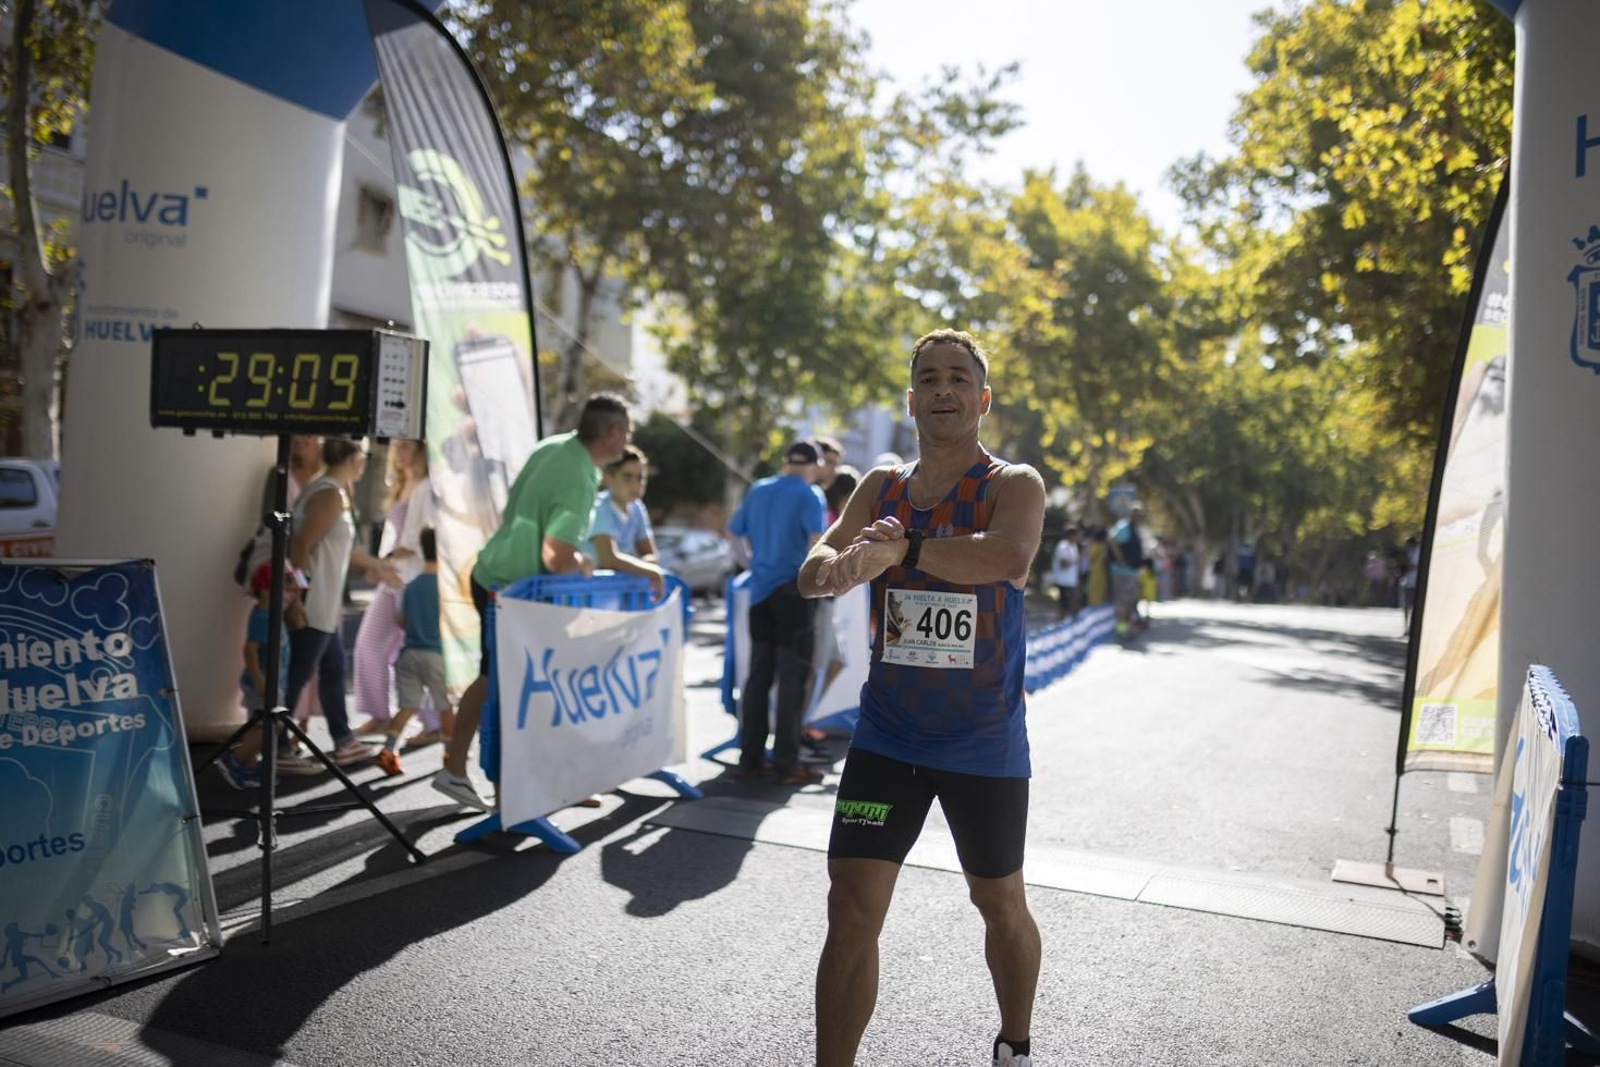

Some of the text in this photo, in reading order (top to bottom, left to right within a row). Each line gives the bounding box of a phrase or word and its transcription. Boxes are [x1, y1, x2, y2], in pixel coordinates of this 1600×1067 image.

[85, 321, 173, 343] HUELV
[916, 606, 972, 641] 406
[23, 713, 146, 746] Deportes
[0, 832, 86, 868] ortes
